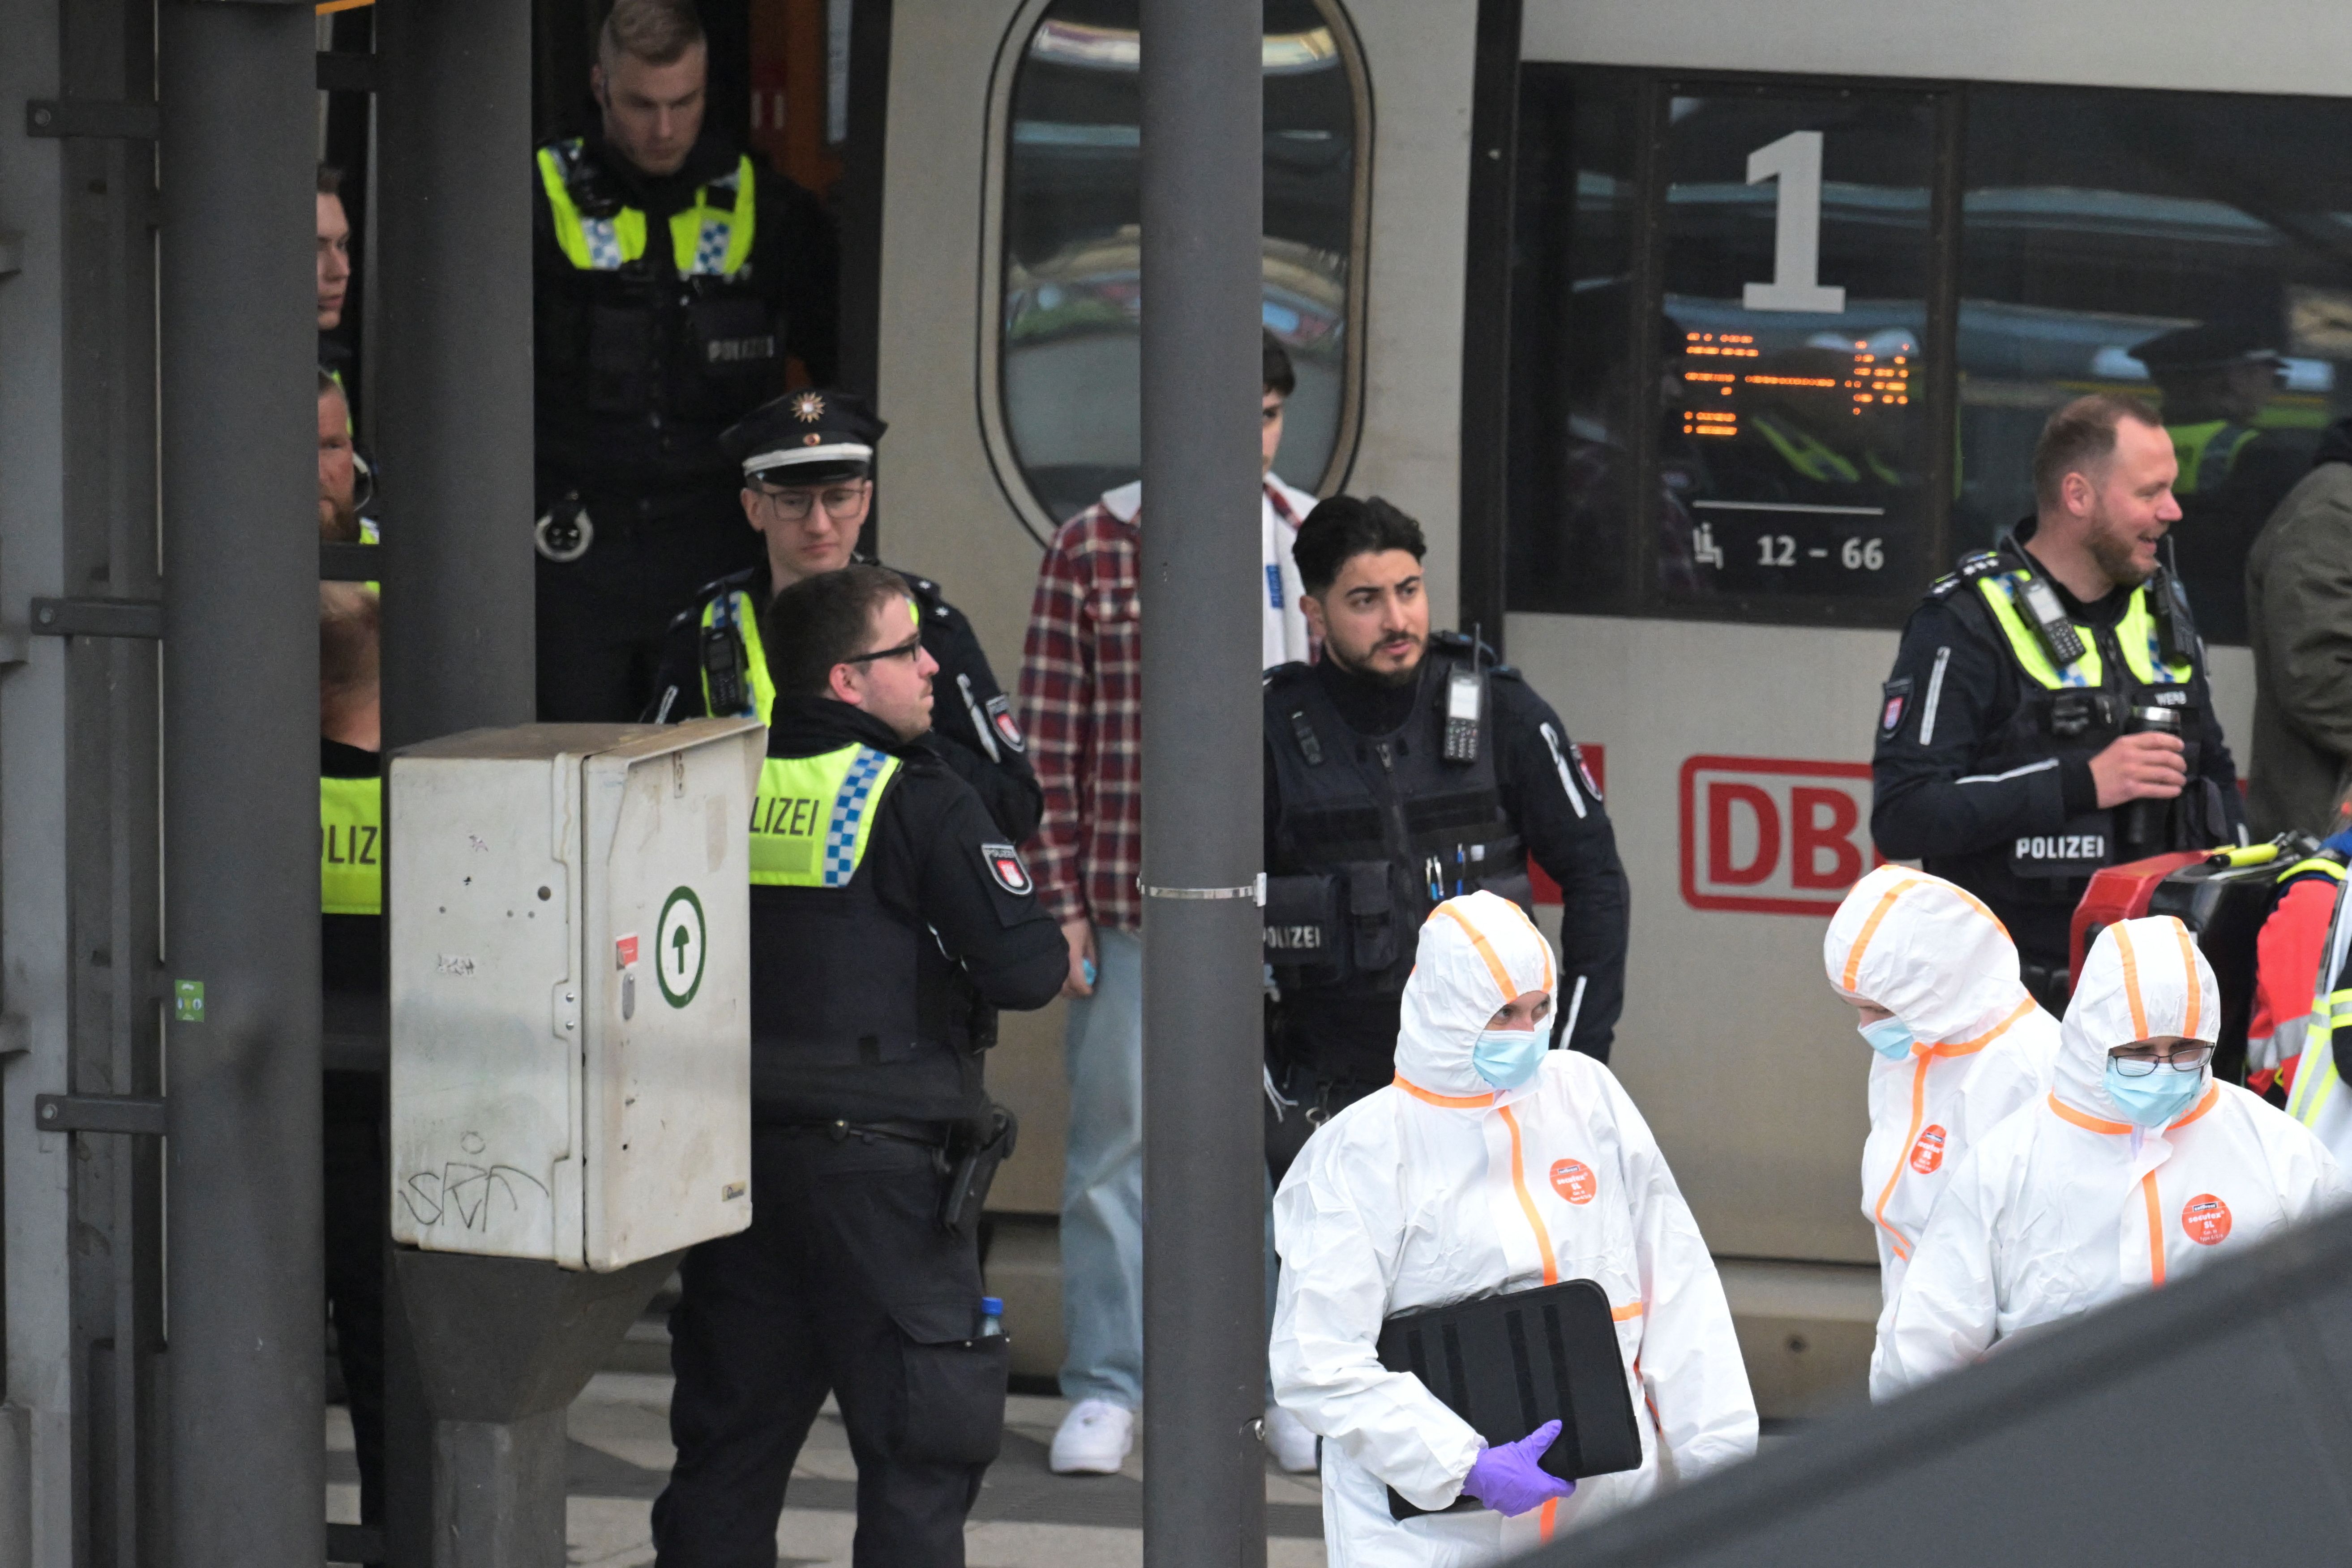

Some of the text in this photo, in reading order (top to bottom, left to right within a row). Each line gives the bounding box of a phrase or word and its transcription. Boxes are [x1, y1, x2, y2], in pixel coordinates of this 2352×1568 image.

[1743, 130, 1846, 313] 1
[1757, 535, 1797, 566] 12
[1841, 537, 1884, 570] 66
[321, 825, 378, 865] LIZ
[1708, 781, 1863, 889] DB
[2015, 835, 2104, 859] POLIZEI
[2204, 1221, 2215, 1229] SL
